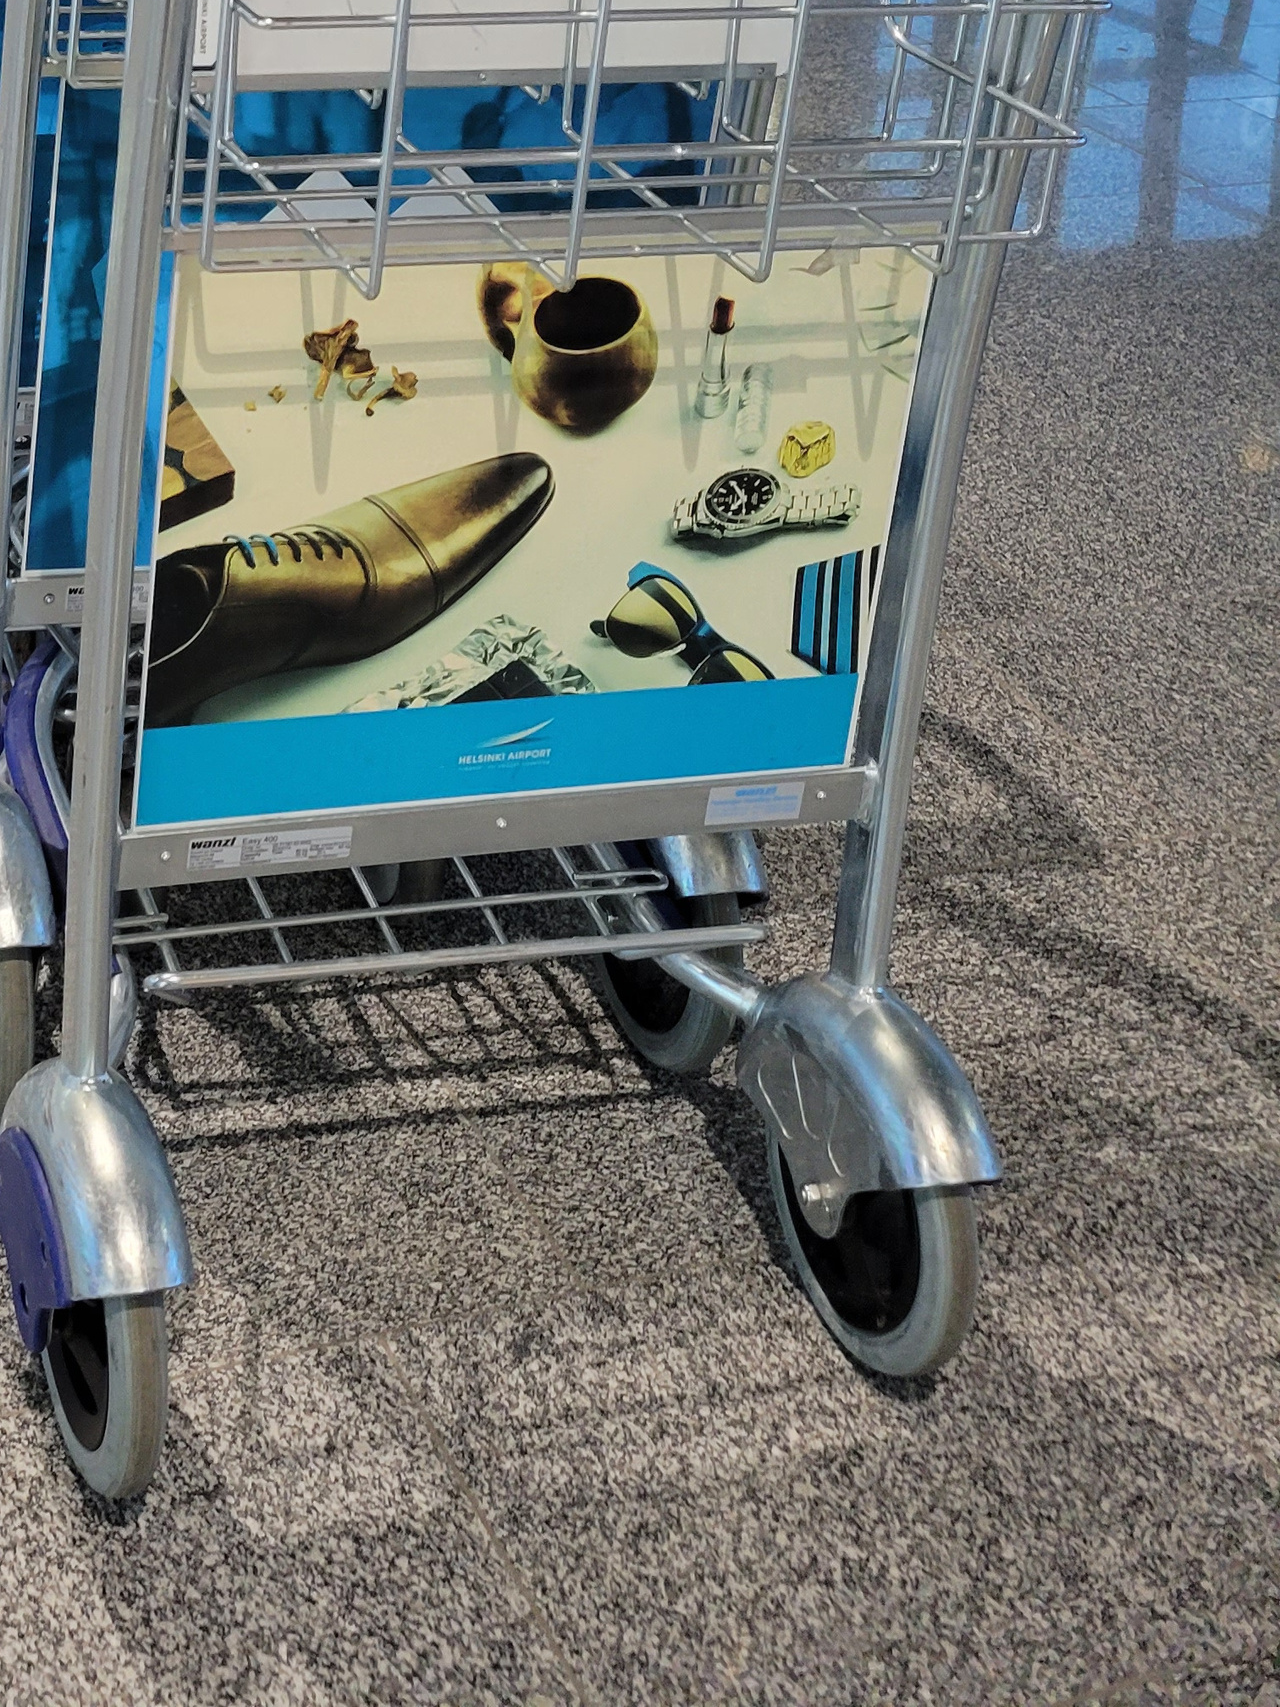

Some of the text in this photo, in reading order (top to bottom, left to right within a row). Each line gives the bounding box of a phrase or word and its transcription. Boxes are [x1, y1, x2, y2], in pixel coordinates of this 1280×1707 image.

[199, 18, 208, 55] AIRPORT
[458, 748, 552, 765] HELSINKI AIRPORT
[242, 838, 262, 846] Easy
